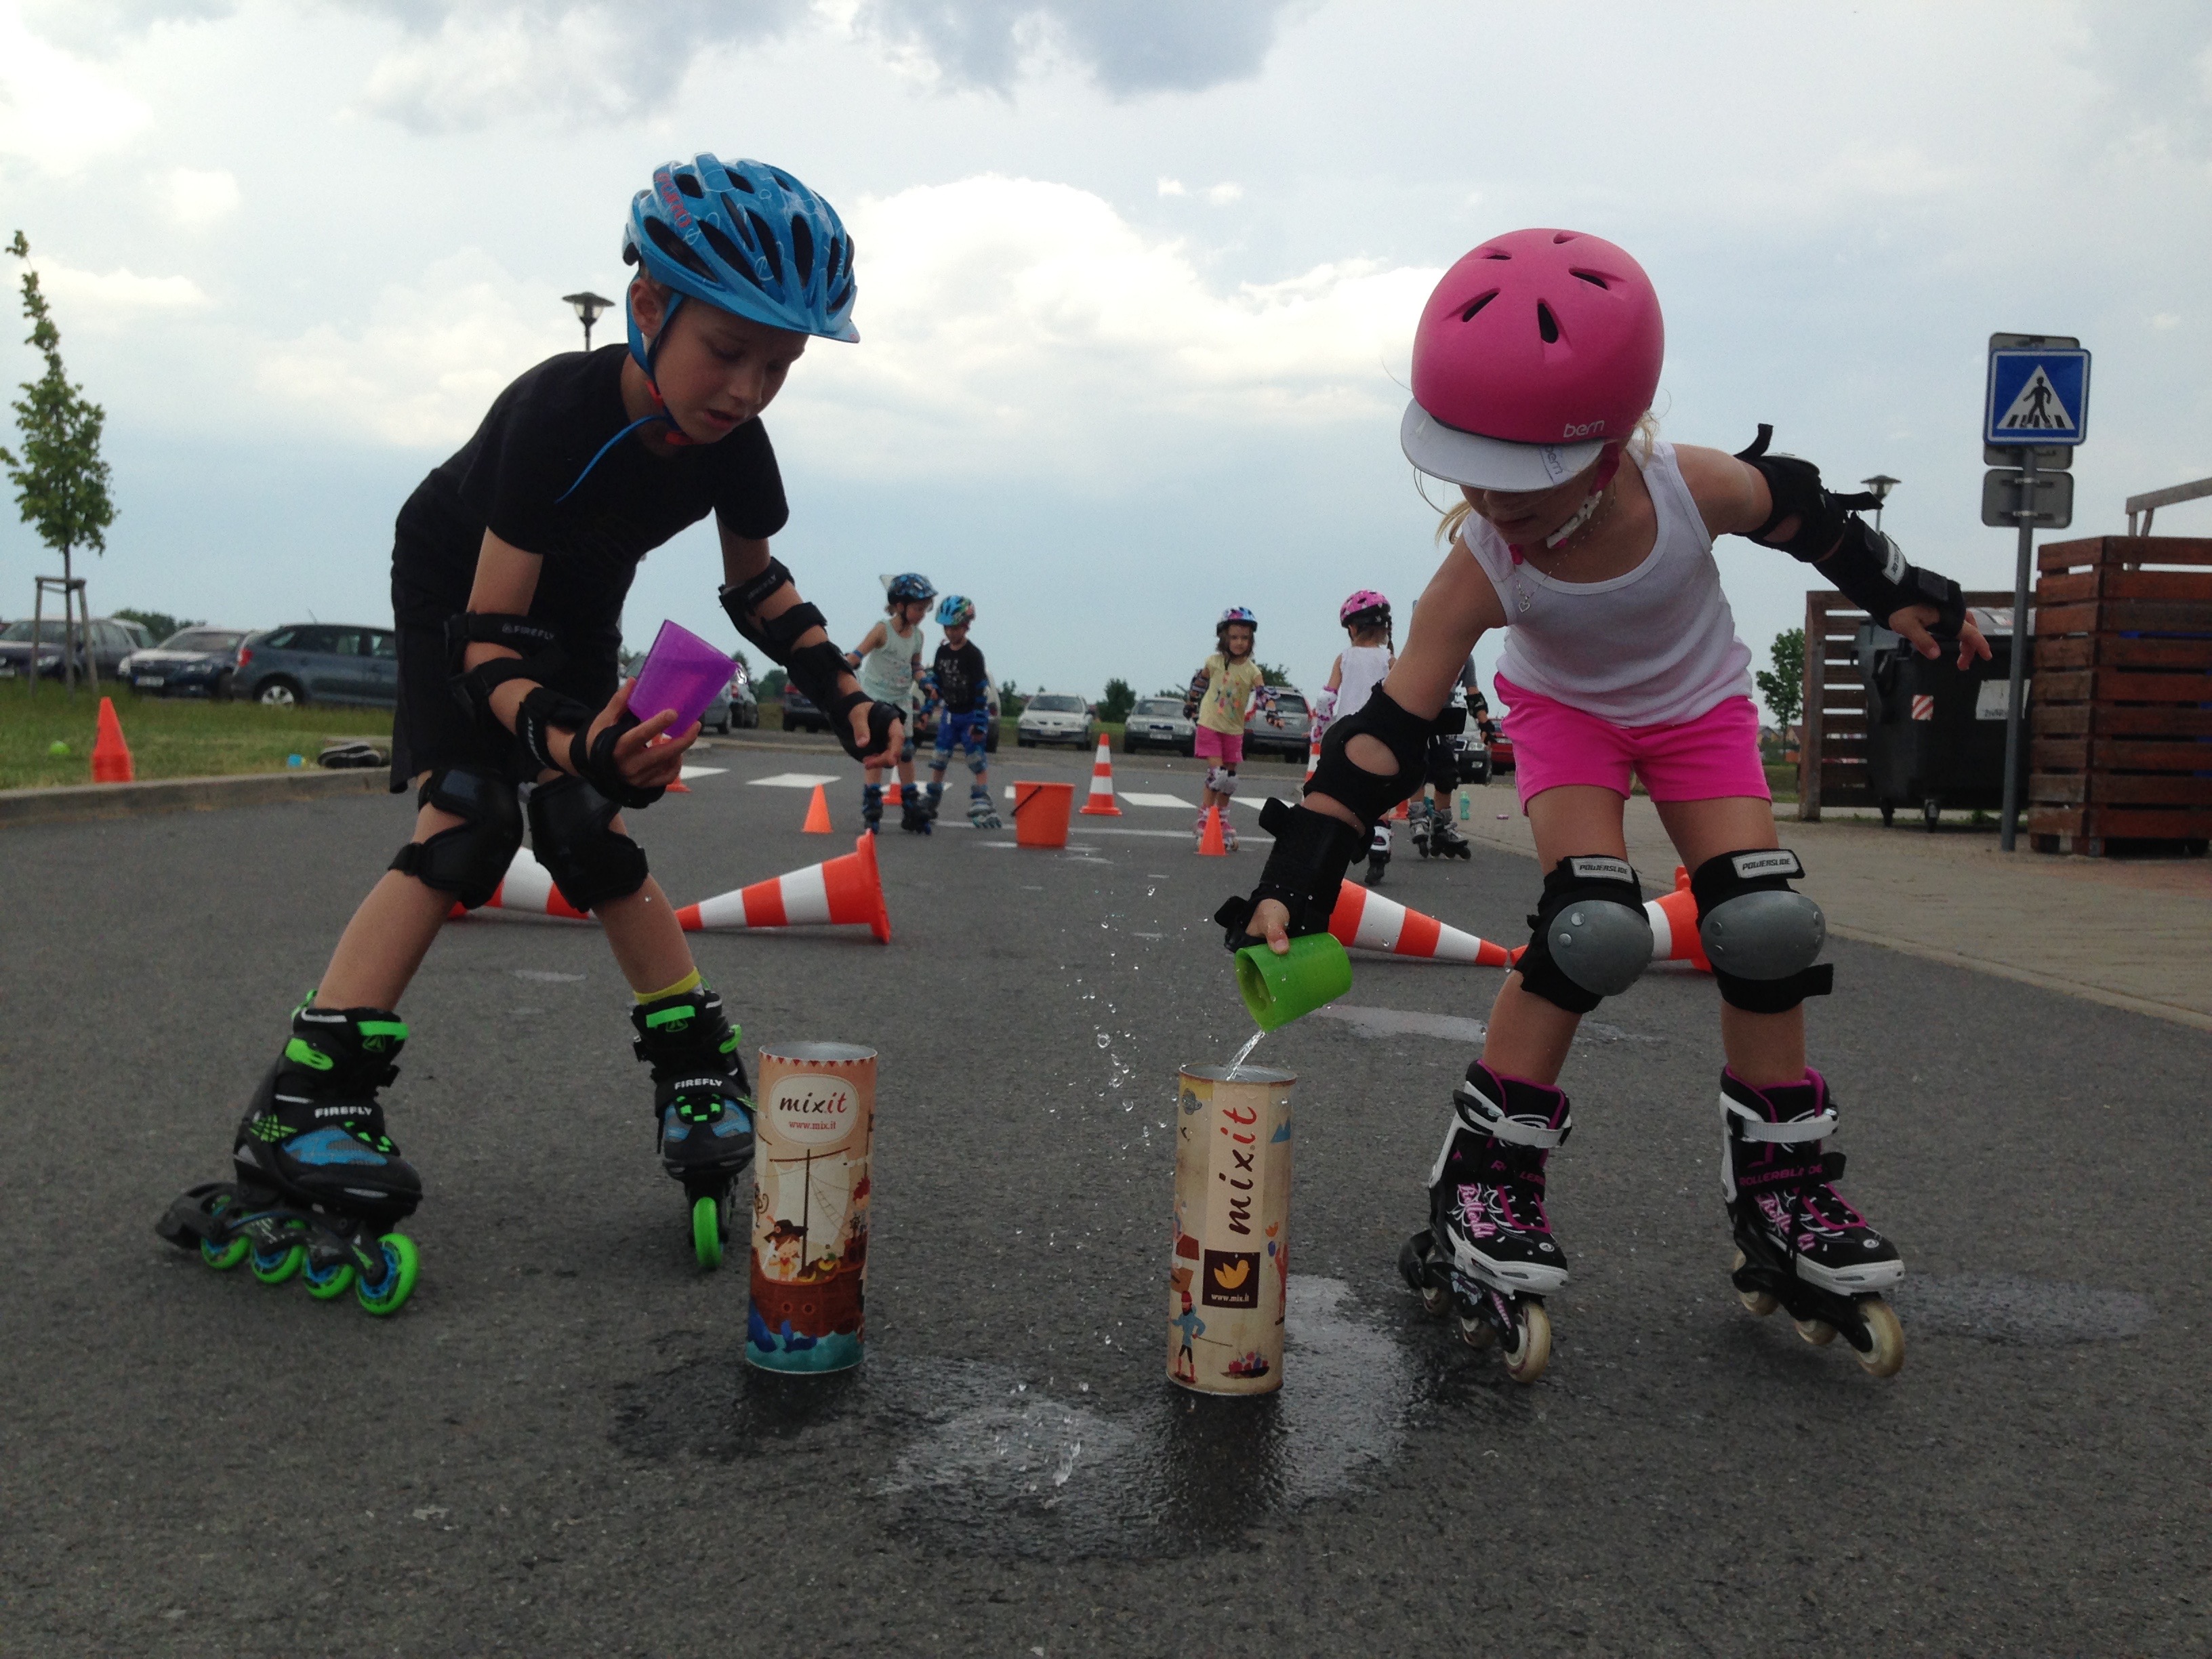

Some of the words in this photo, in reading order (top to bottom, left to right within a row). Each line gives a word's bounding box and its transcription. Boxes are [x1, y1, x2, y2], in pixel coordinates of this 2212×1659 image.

[1563, 419, 1605, 438] bern
[1742, 858, 1790, 870] POWERSLIDE
[674, 1078, 722, 1090] FIREFLY
[779, 1092, 847, 1113] mixit
[315, 1106, 372, 1118] FIREFLY
[789, 1121, 836, 1130] www.mix.it
[1220, 1107, 1257, 1235] mixit
